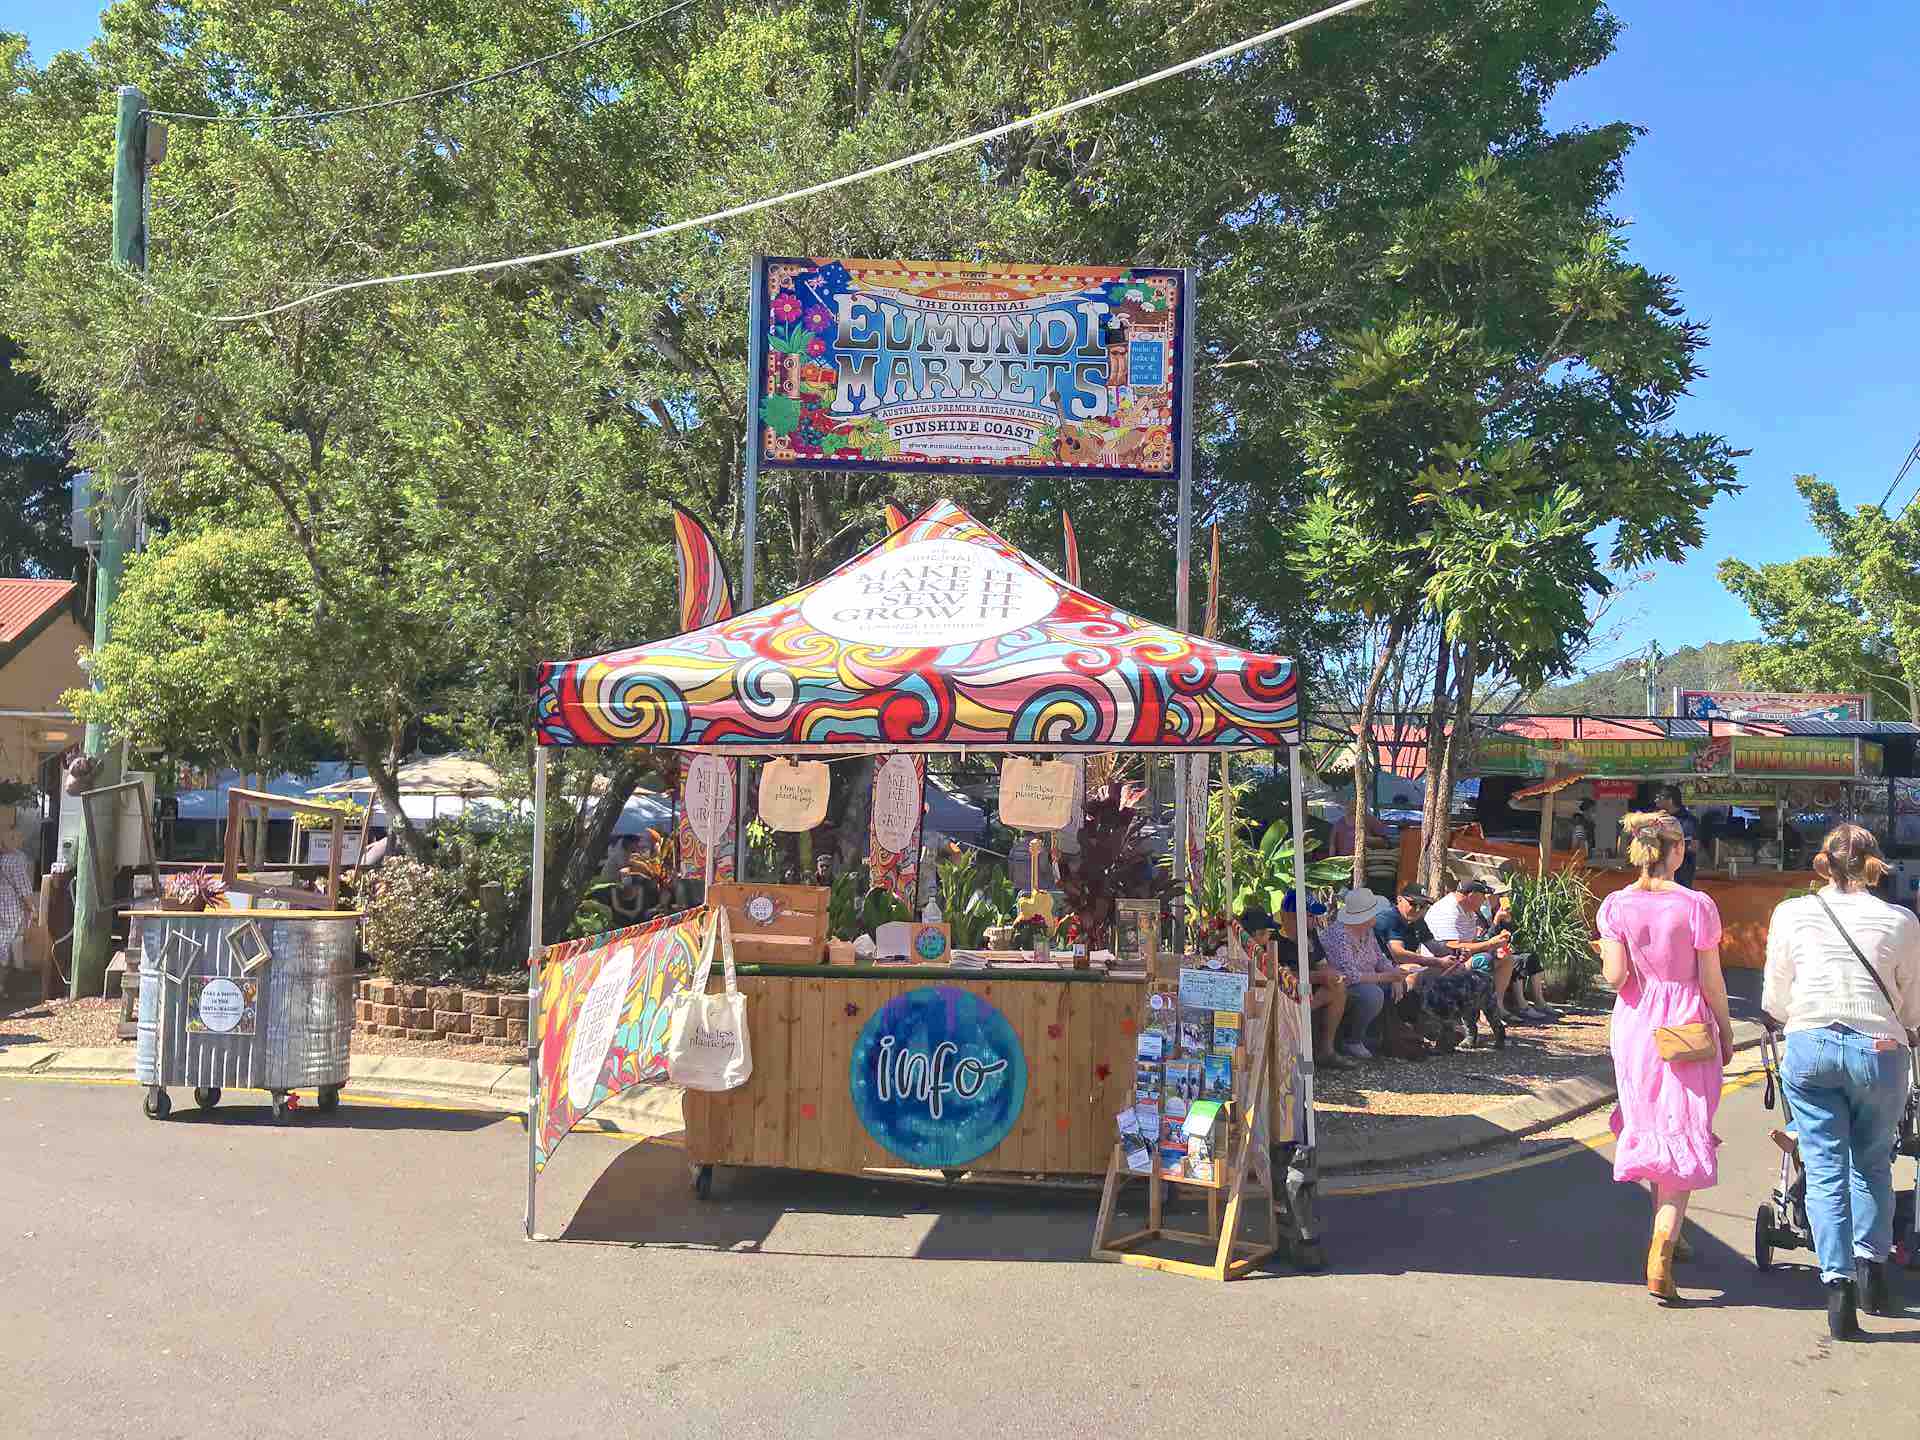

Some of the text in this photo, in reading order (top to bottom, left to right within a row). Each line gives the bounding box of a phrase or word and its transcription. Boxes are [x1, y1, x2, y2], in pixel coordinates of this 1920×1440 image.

[916, 300, 1029, 312] THE ORIGINAL
[833, 293, 1110, 357] EUMUNDI
[831, 354, 1111, 420] MARKETS
[882, 403, 936, 417] AUSTRALIA'S
[938, 403, 977, 413] PREMIER
[979, 404, 1016, 416] ARTISAN
[894, 420, 1034, 440] SUNSHINE COAST
[856, 565, 1017, 583] MAKE IT
[862, 579, 1021, 595] BAKE IT
[881, 591, 1021, 607] SEW IT
[832, 606, 1021, 622] GROW IT
[1735, 751, 1854, 769] DUMPLINGS
[878, 1036, 1008, 1120] info
